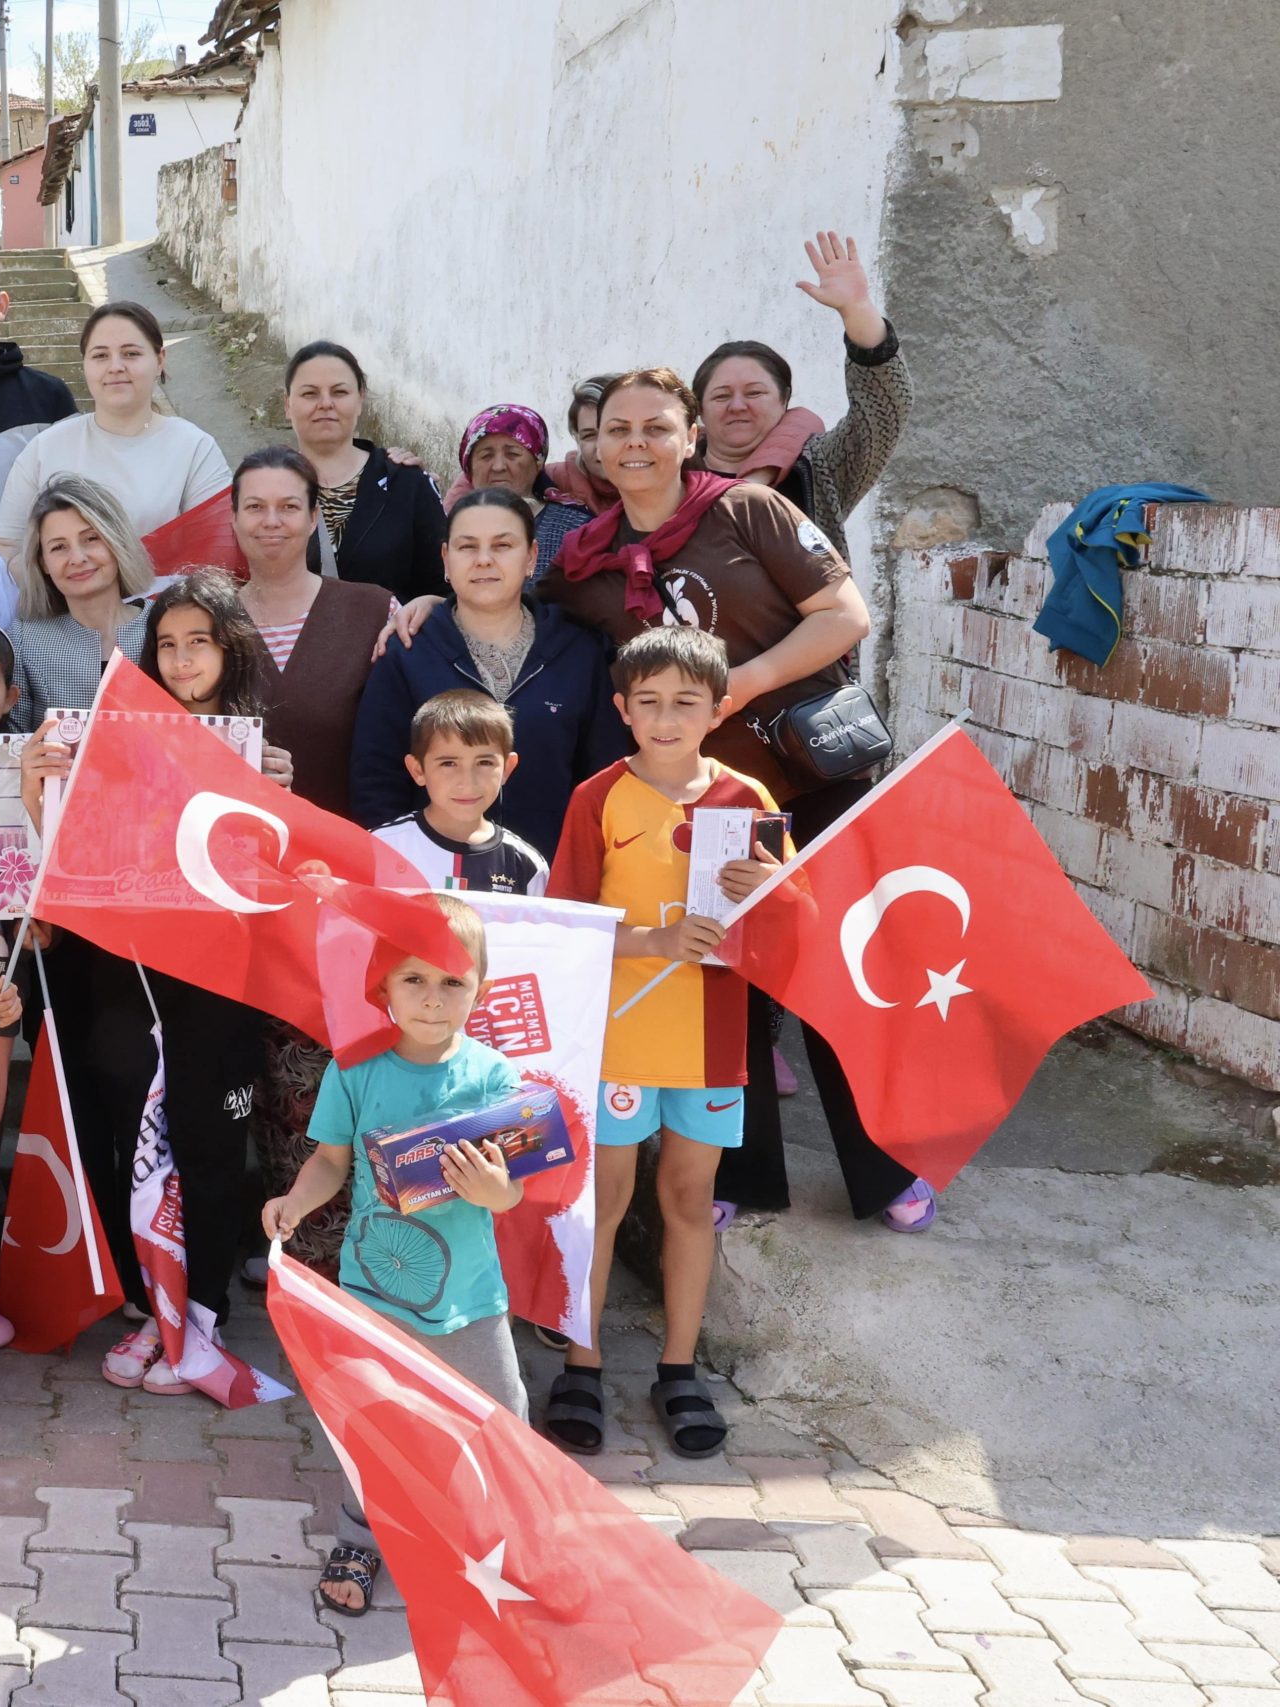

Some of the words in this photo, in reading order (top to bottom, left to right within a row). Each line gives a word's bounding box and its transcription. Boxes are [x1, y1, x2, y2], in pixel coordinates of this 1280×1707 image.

[810, 726, 839, 748] Calvin
[837, 720, 858, 736] Klein
[858, 714, 878, 728] Jeans
[486, 983, 528, 1053] İÇİN
[518, 980, 544, 1048] MENEMEN
[396, 1144, 437, 1168] PARS
[408, 1189, 443, 1206] UZAKTAN
